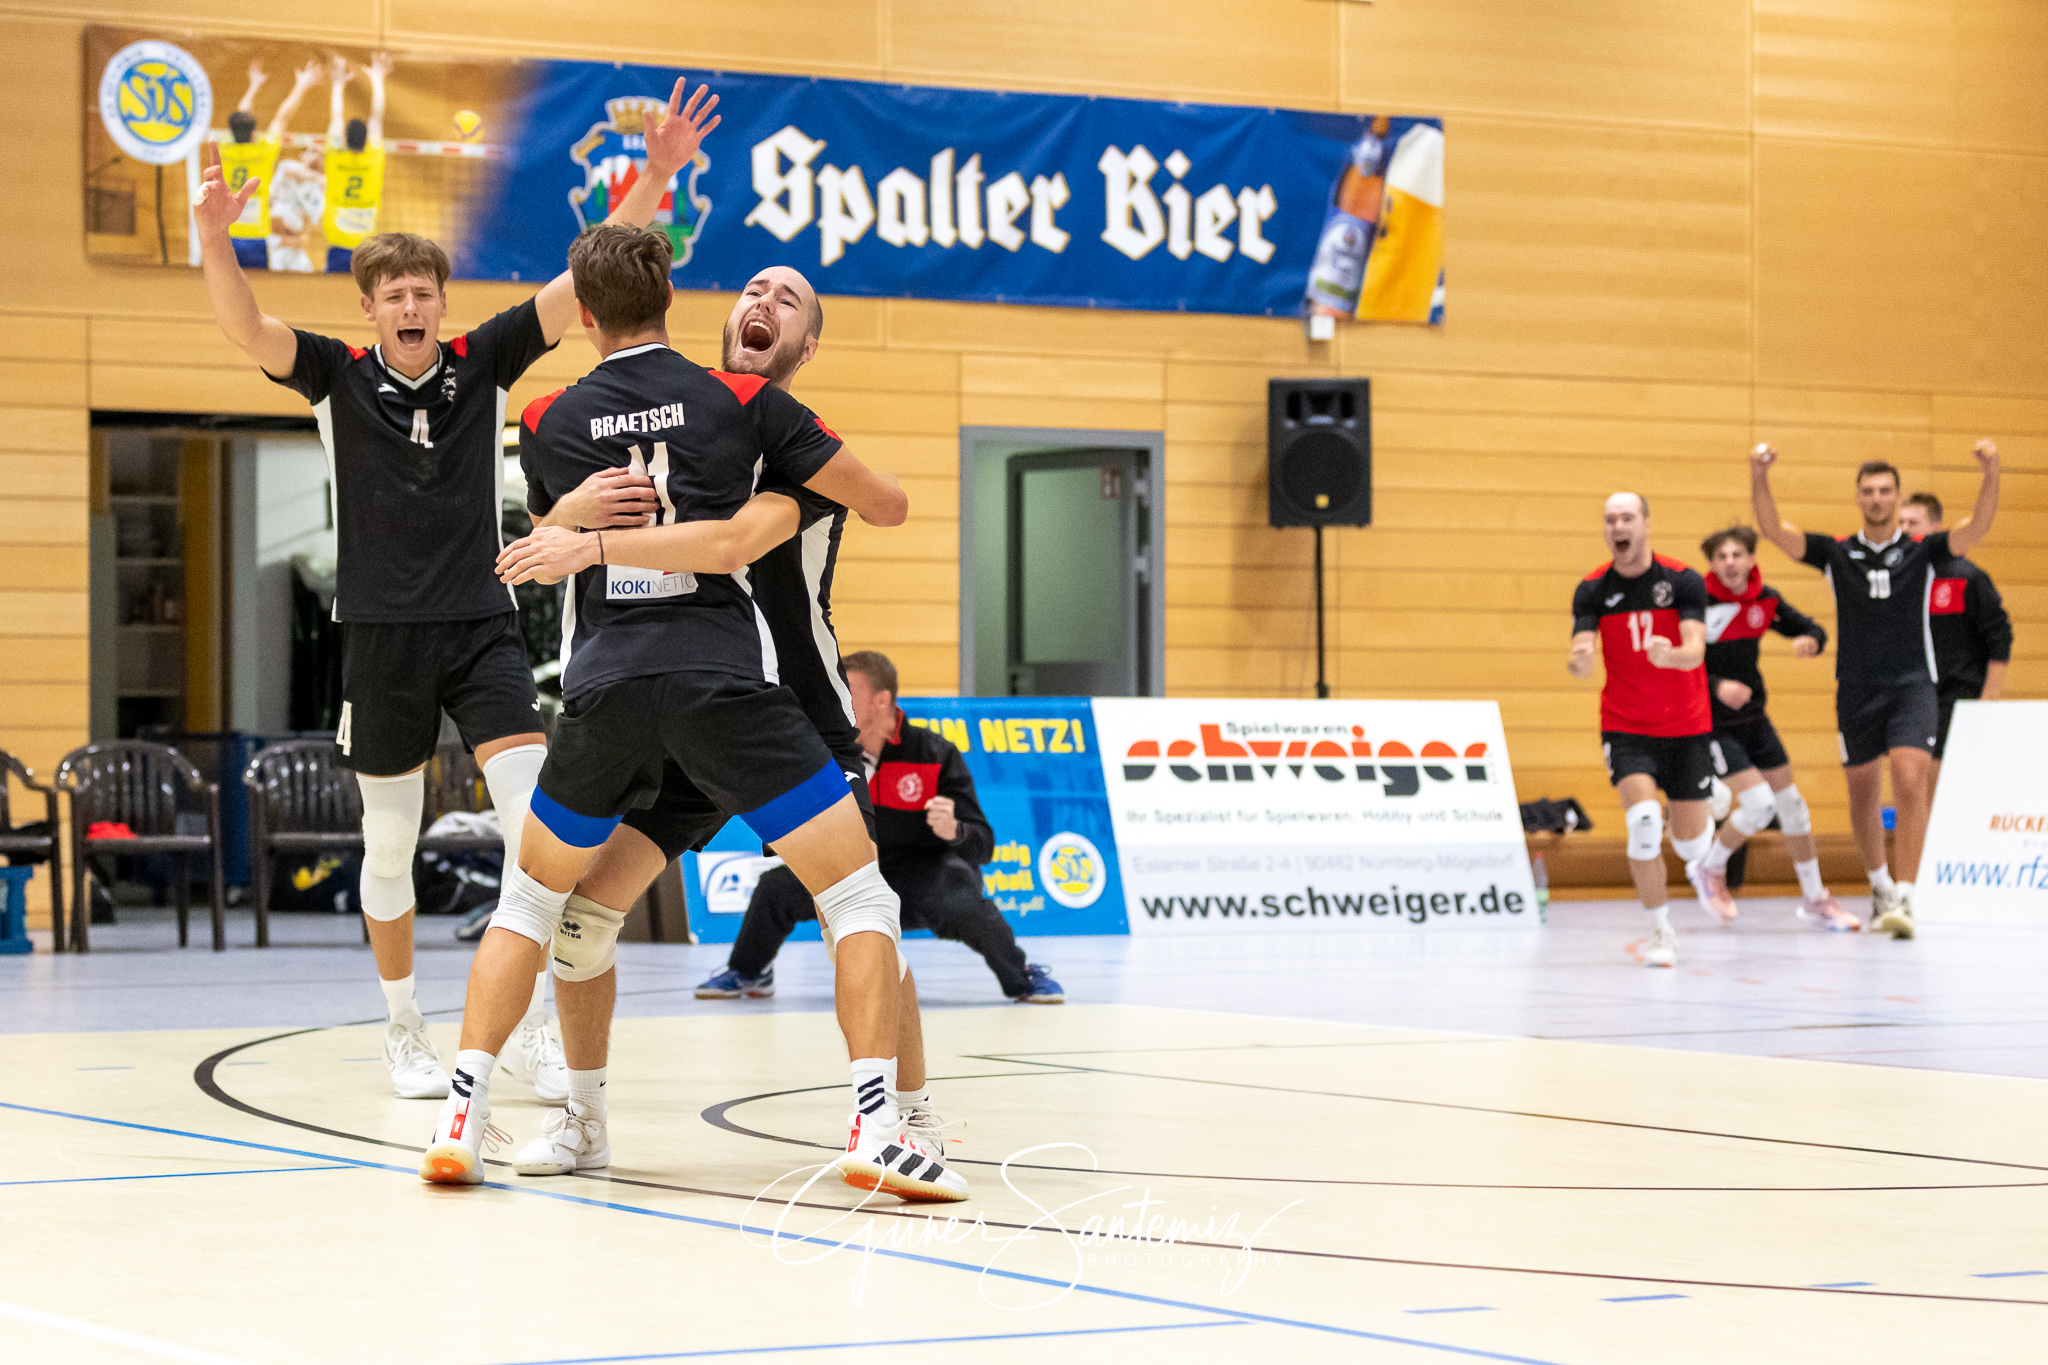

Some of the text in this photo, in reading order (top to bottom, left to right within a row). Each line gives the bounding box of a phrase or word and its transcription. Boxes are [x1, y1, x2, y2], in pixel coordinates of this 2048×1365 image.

[344, 176, 363, 199] 2
[744, 125, 1278, 267] Spalter Bier
[410, 409, 434, 449] 4
[590, 403, 685, 441] BRAETSCH
[336, 701, 352, 756] 4
[979, 718, 1085, 753] NETZ!
[1227, 722, 1348, 737] Spielwaren
[1123, 724, 1488, 797] schweiger
[1154, 809, 1232, 824] Spezialist
[1419, 808, 1447, 821] und
[1453, 808, 1503, 821] Schule
[1989, 811, 2048, 832] RÜCKE
[1140, 884, 1524, 924] www.schweiger.de
